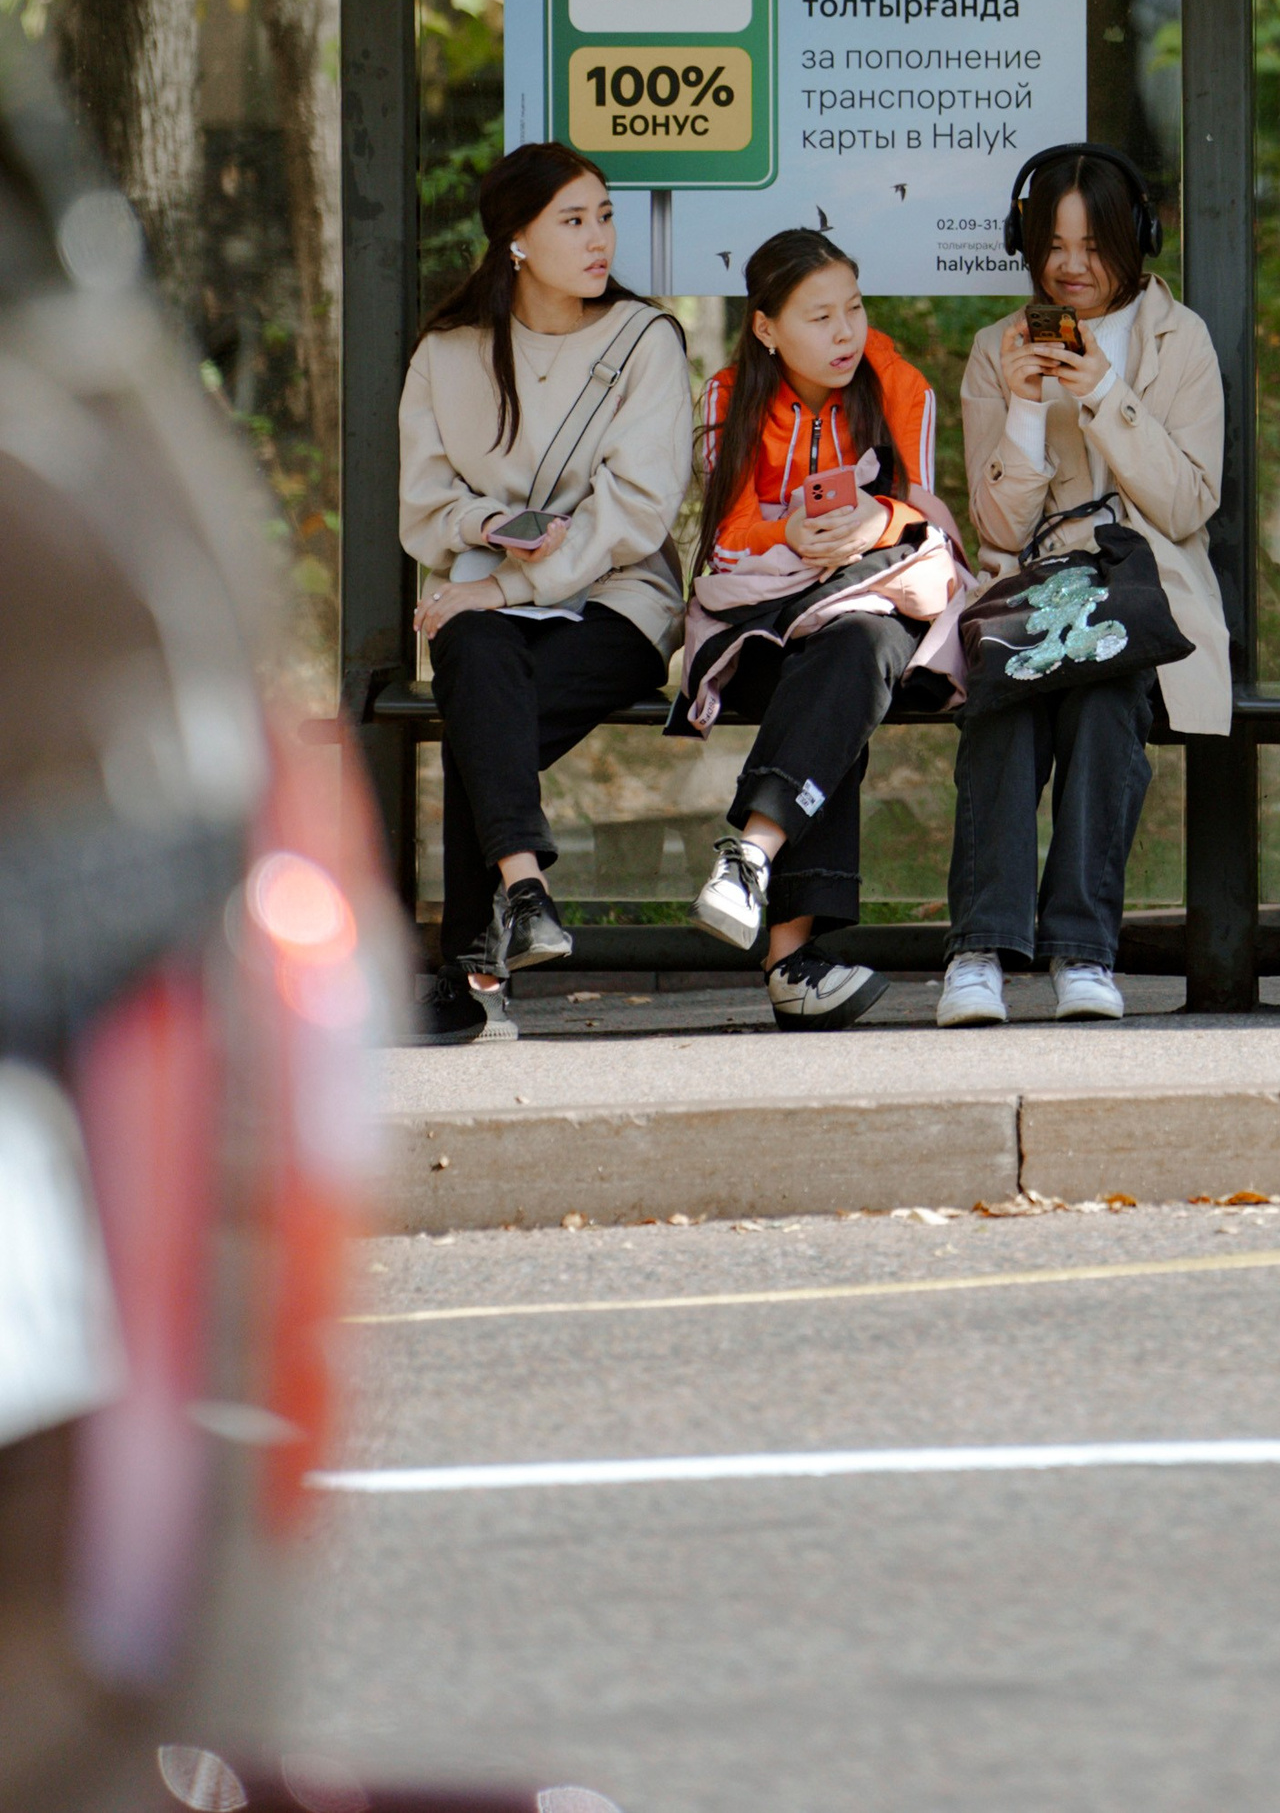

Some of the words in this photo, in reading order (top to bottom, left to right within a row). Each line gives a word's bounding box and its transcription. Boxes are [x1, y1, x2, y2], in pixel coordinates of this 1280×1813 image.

[801, 49, 835, 70] за
[845, 49, 1041, 70] пополнение
[586, 65, 735, 108] 100%
[801, 81, 1032, 113] транспортной
[611, 114, 710, 137] БОНУС
[801, 129, 895, 153] карты
[906, 129, 922, 149] в
[932, 121, 1018, 155] Halyk
